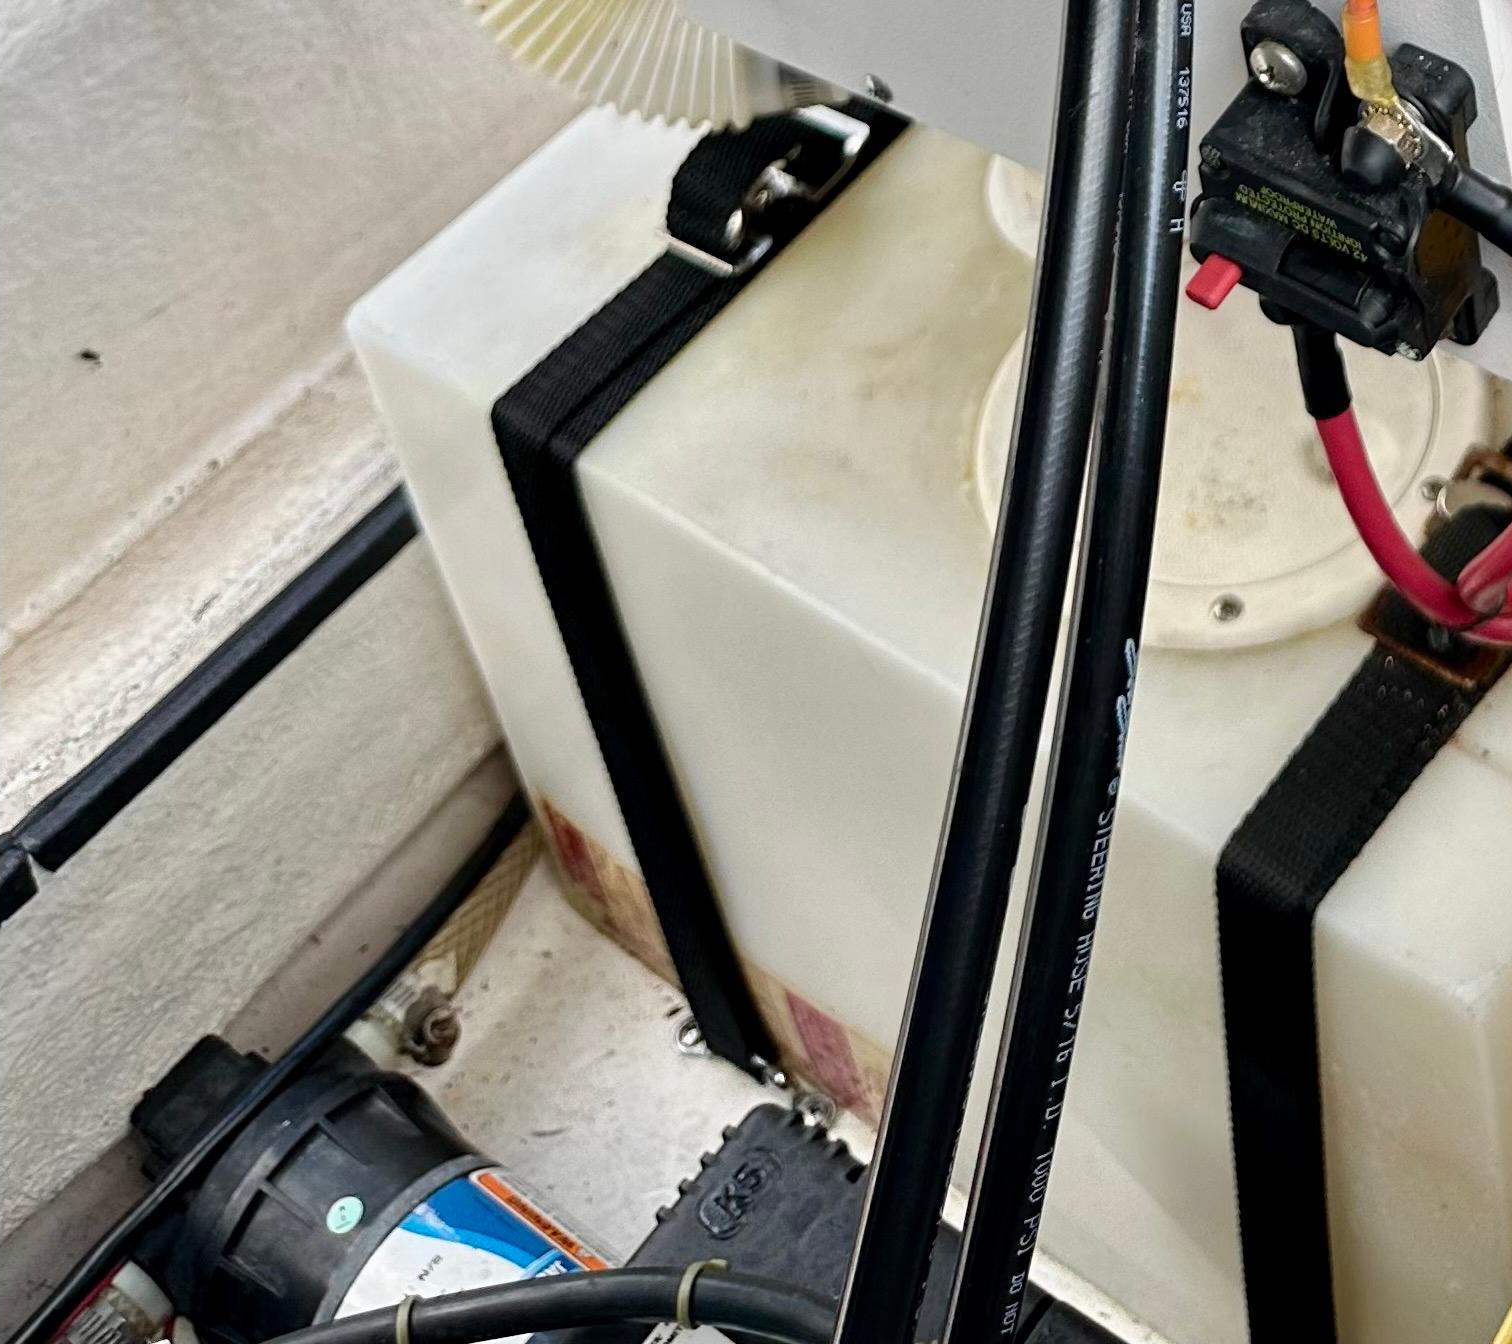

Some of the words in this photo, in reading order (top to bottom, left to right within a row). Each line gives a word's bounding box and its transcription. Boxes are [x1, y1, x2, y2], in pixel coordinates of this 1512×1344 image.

[1179, 3, 1193, 37] USA
[1175, 67, 1191, 130] 137516
[1082, 810, 1117, 920] STEERING
[1009, 1271, 1025, 1295] DO
[1000, 1305, 1019, 1336] NOT
